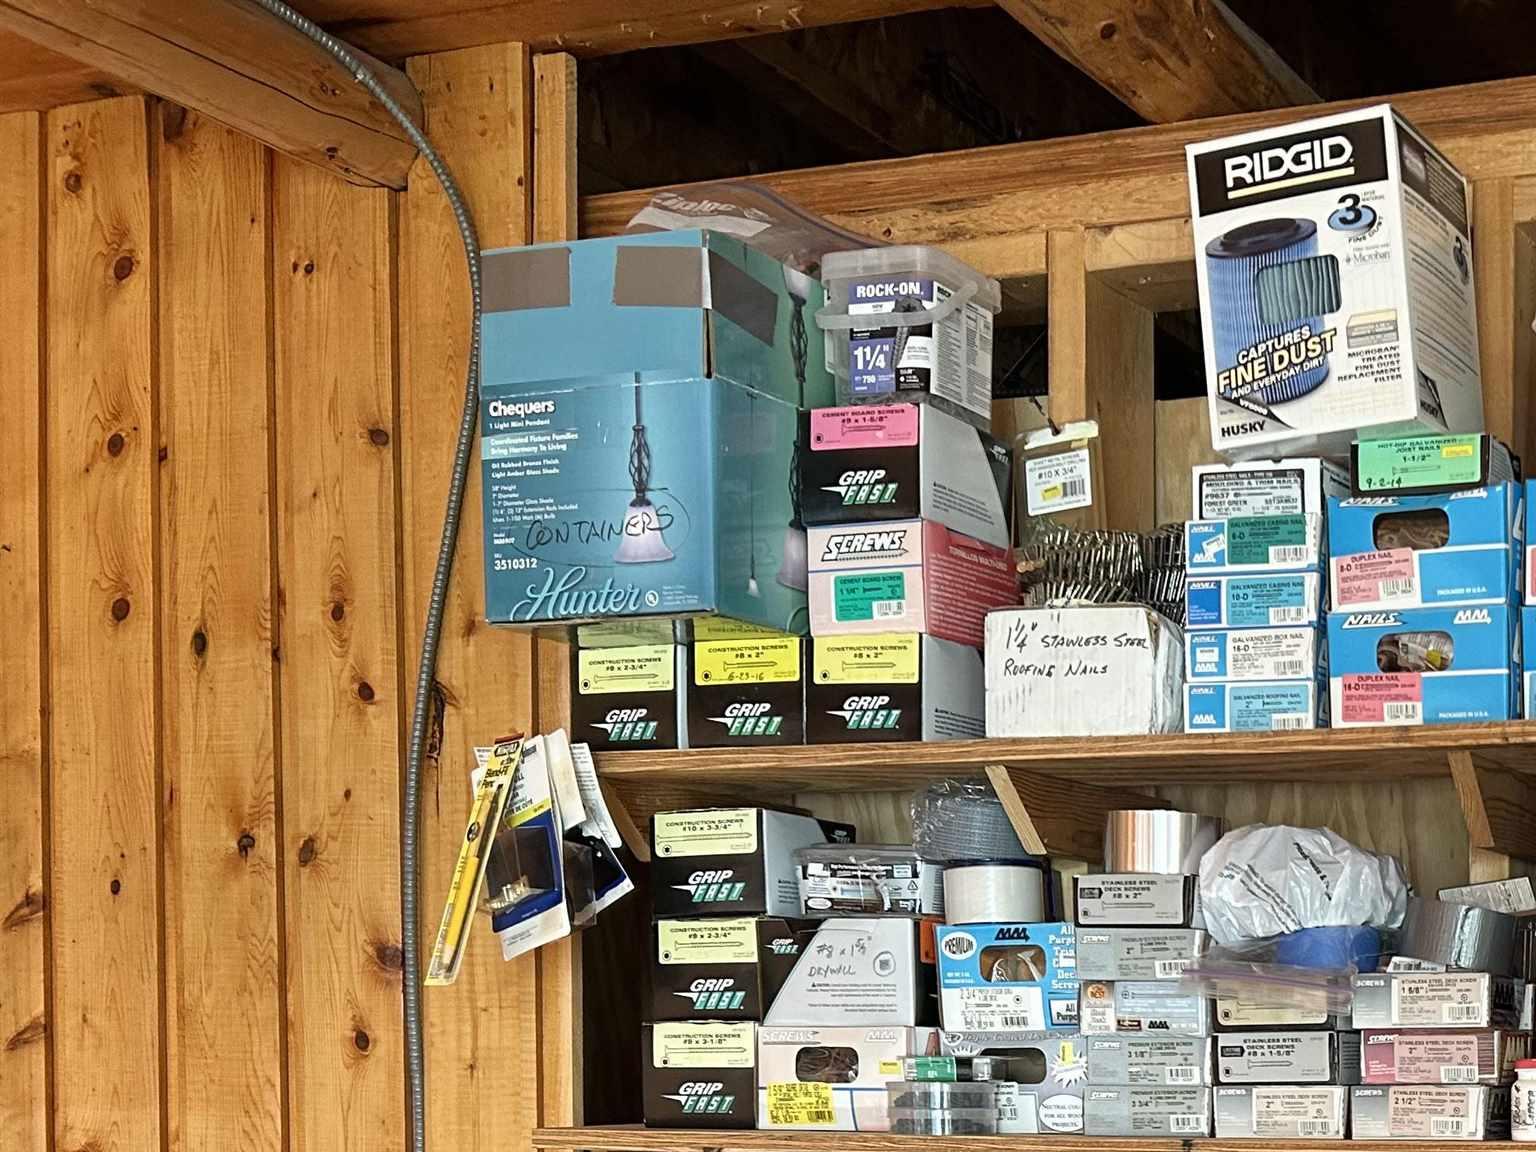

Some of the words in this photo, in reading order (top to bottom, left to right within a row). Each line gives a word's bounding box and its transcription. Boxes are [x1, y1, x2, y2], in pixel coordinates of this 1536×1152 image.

[1224, 135, 1355, 188] RIDGID
[1338, 194, 1362, 225] 3
[1238, 325, 1311, 364] CAPTURES
[1217, 357, 1268, 394] FINE
[1272, 328, 1337, 372] DUST
[1355, 363, 1375, 372] FINE
[1377, 360, 1401, 369] DUST
[1361, 353, 1401, 364] TREATED
[1231, 384, 1251, 399] AND
[1253, 365, 1301, 392] EVERYDAY
[1303, 357, 1325, 371] DIRT
[1337, 367, 1401, 382] REPLACEMENT
[1374, 374, 1403, 384] FILTER
[488, 400, 556, 418] Chequers
[1221, 420, 1267, 438] HUSKY
[838, 469, 887, 485] GRIP
[525, 504, 674, 550] CONTAINERS
[821, 530, 908, 562] SCREWS
[494, 558, 538, 571] 3510312
[510, 566, 640, 621] Hunter
[1341, 611, 1403, 629] NAILS
[707, 646, 760, 654] CONSTRUCTION
[1064, 659, 1108, 677] NAILS
[725, 702, 771, 717] GRIP
[844, 695, 890, 710] GRIP
[605, 708, 648, 724] GRIP
[688, 870, 734, 884] GRIP
[690, 979, 735, 992] GRIP
[678, 1082, 724, 1095] GRIP
